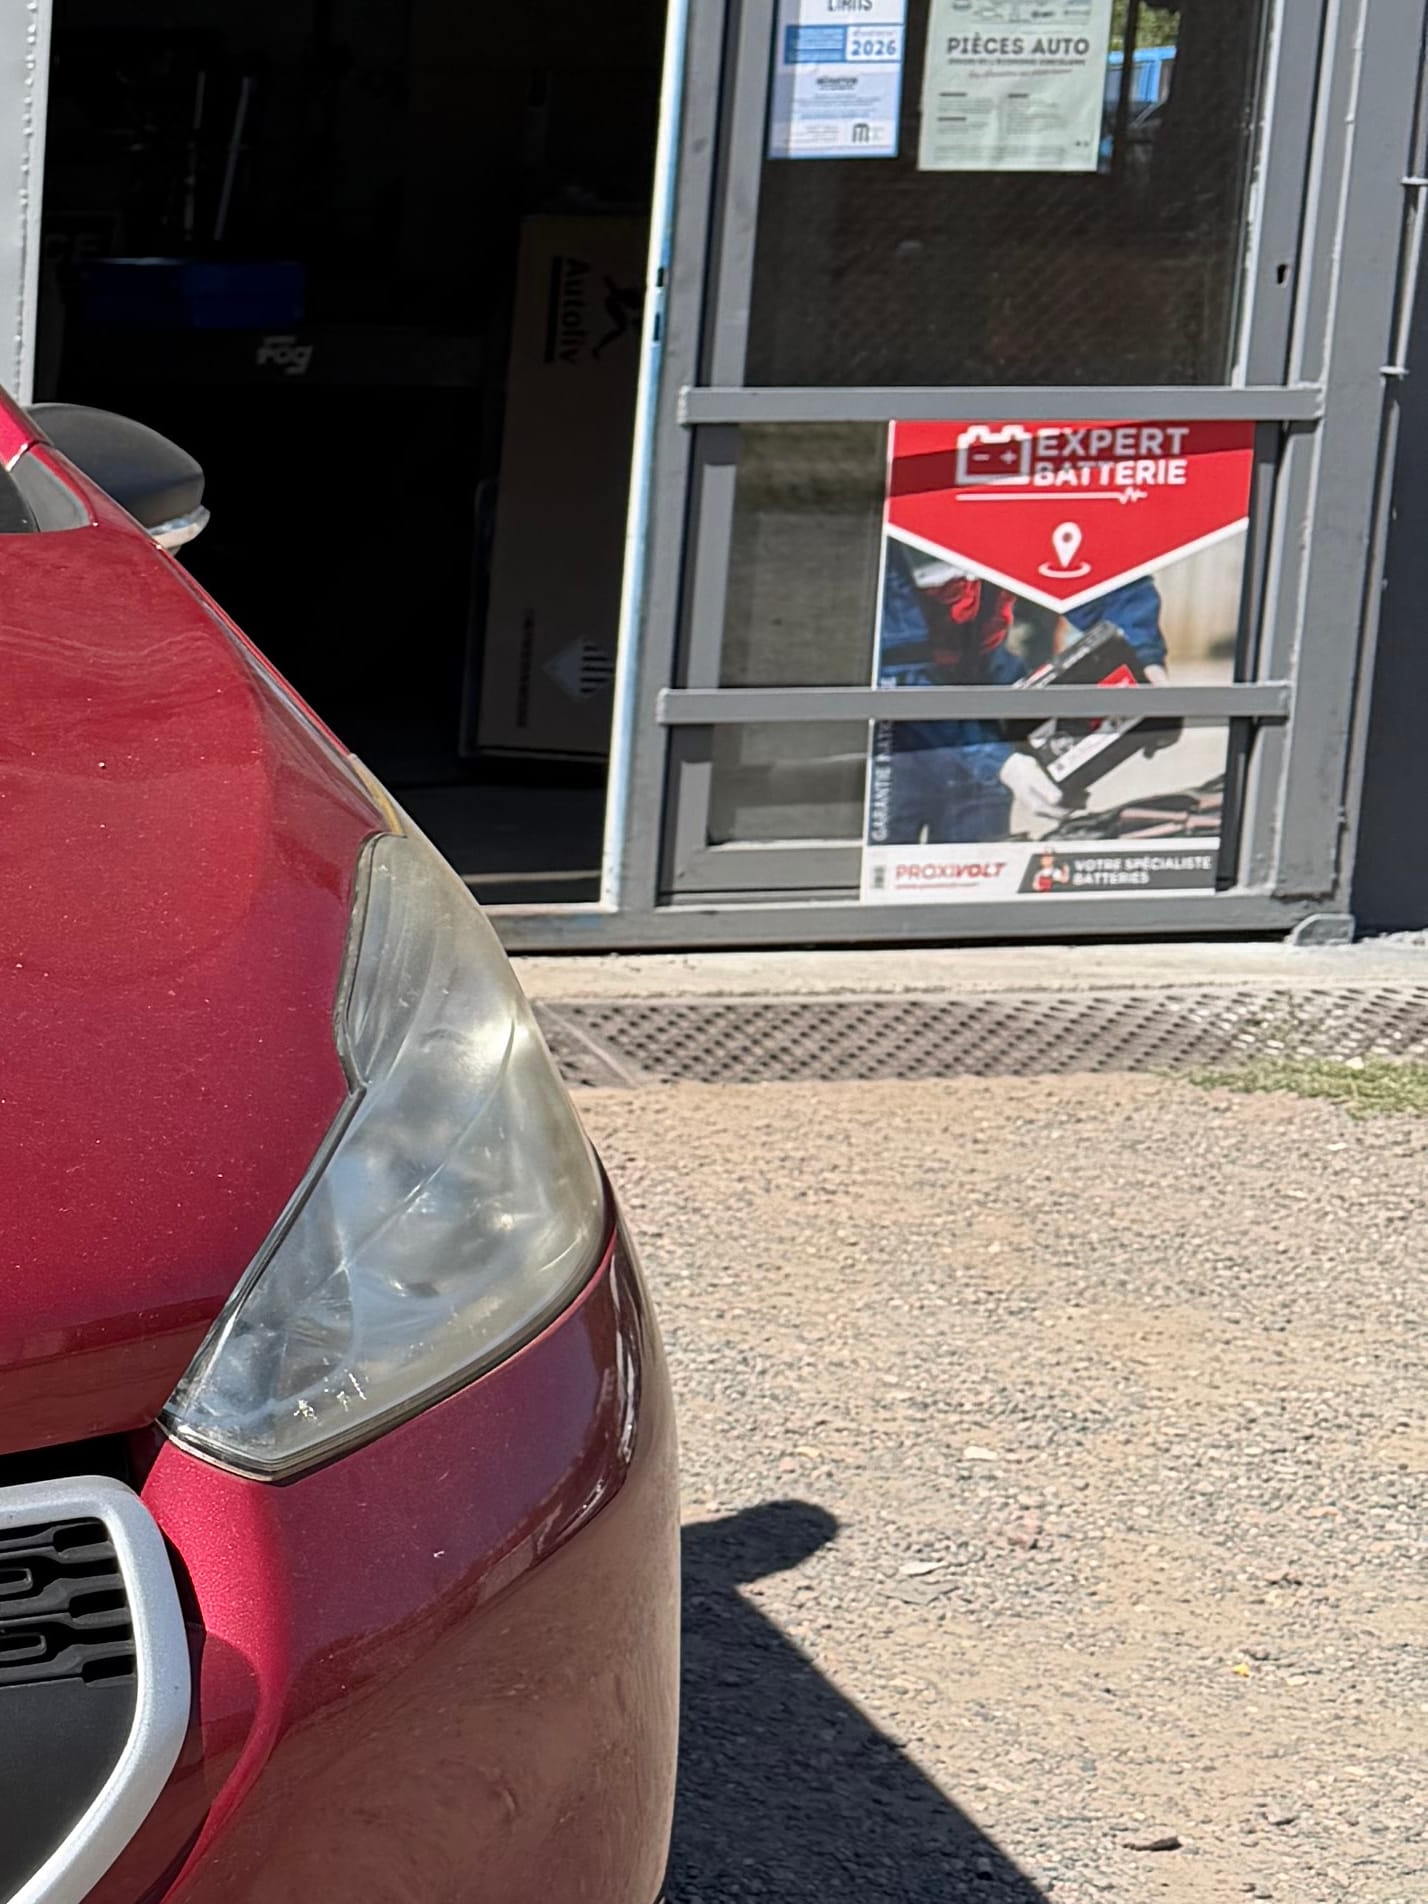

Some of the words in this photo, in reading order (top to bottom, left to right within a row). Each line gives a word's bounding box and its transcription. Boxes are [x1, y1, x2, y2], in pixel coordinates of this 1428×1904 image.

[852, 39, 896, 56] 2026
[947, 32, 1025, 55] PIÈCES
[1031, 37, 1091, 56] AUTO
[559, 257, 592, 365] Autoliv
[1035, 427, 1191, 458] EXPERT
[1033, 459, 1189, 487] BATTERIE
[871, 767, 890, 841] GARANTIE
[895, 862, 1006, 879] PROXIVOLT
[1074, 859, 1122, 872] VOTRE
[1124, 856, 1212, 871] SPÉCIALISTE
[1073, 871, 1150, 885] BATTERIES
